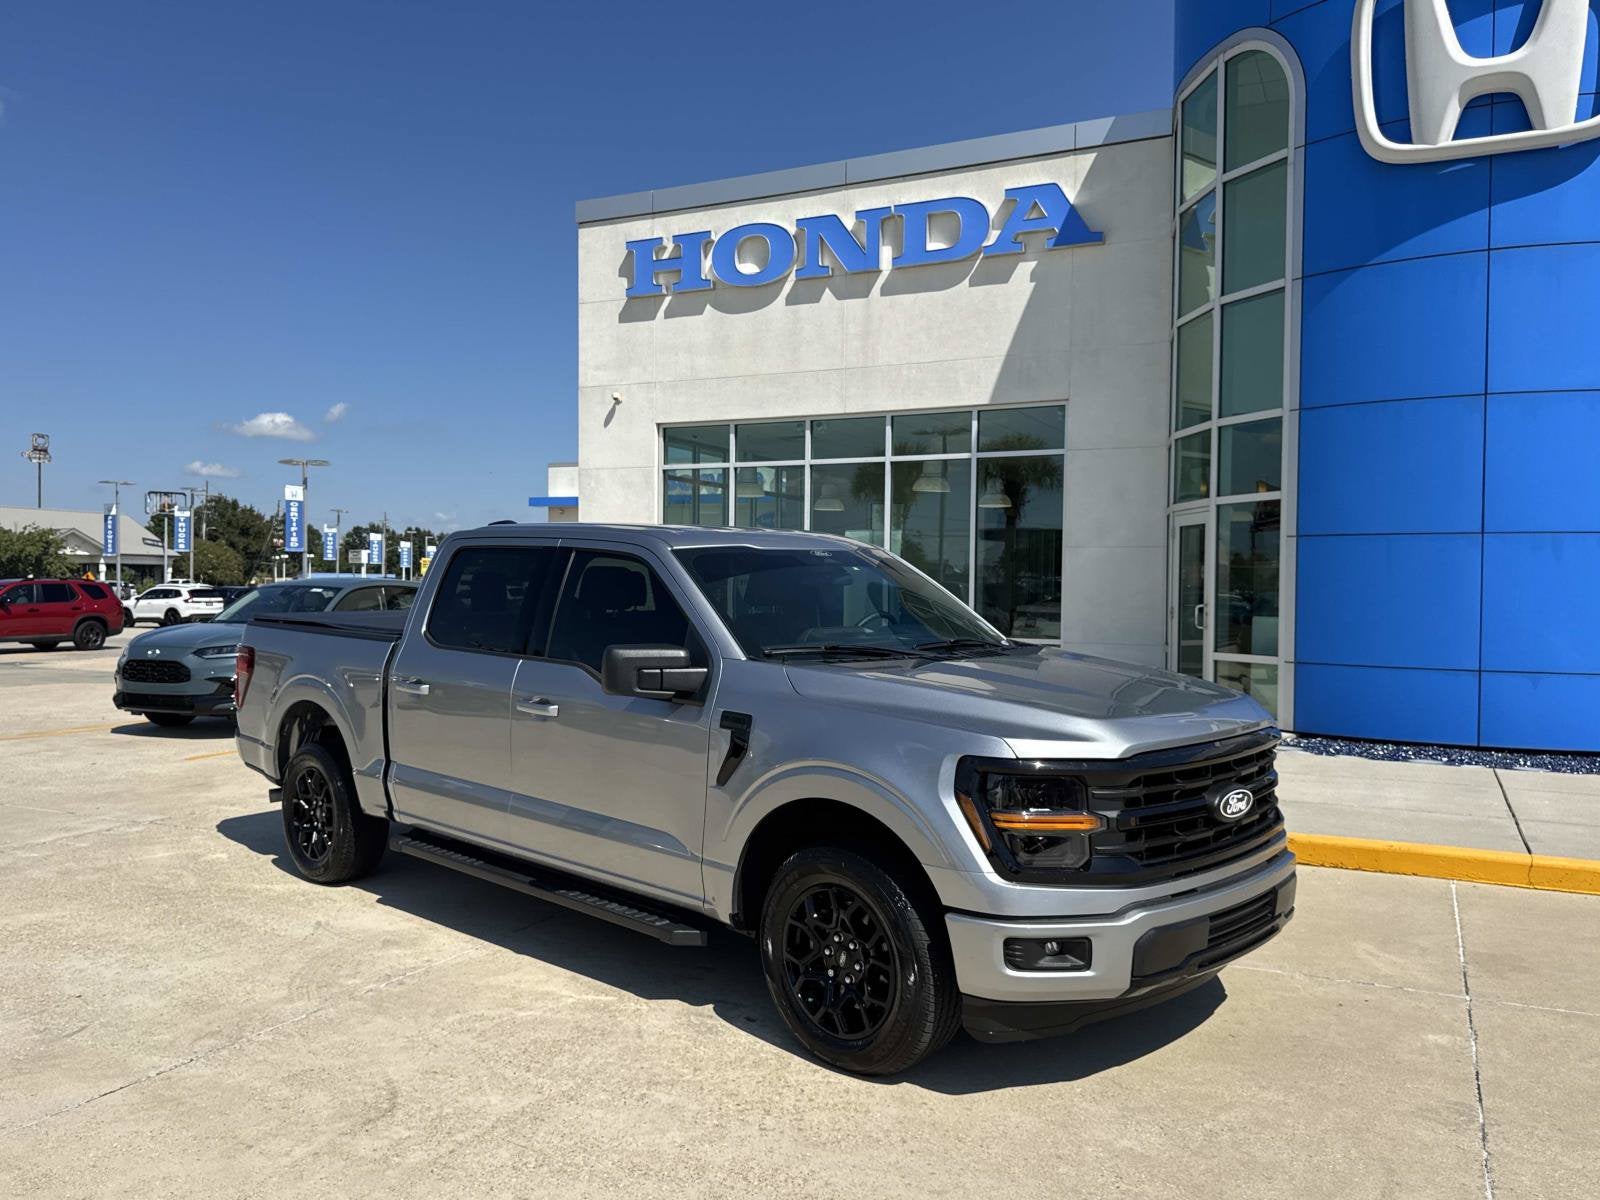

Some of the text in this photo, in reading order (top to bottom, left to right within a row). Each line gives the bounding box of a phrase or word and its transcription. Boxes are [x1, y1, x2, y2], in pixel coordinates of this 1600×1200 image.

[625, 182, 1105, 298] HONDA
[177, 516, 186, 549] TRUCKS
[290, 501, 299, 548] CERTIFIED
[1226, 793, 1248, 815] Ford
